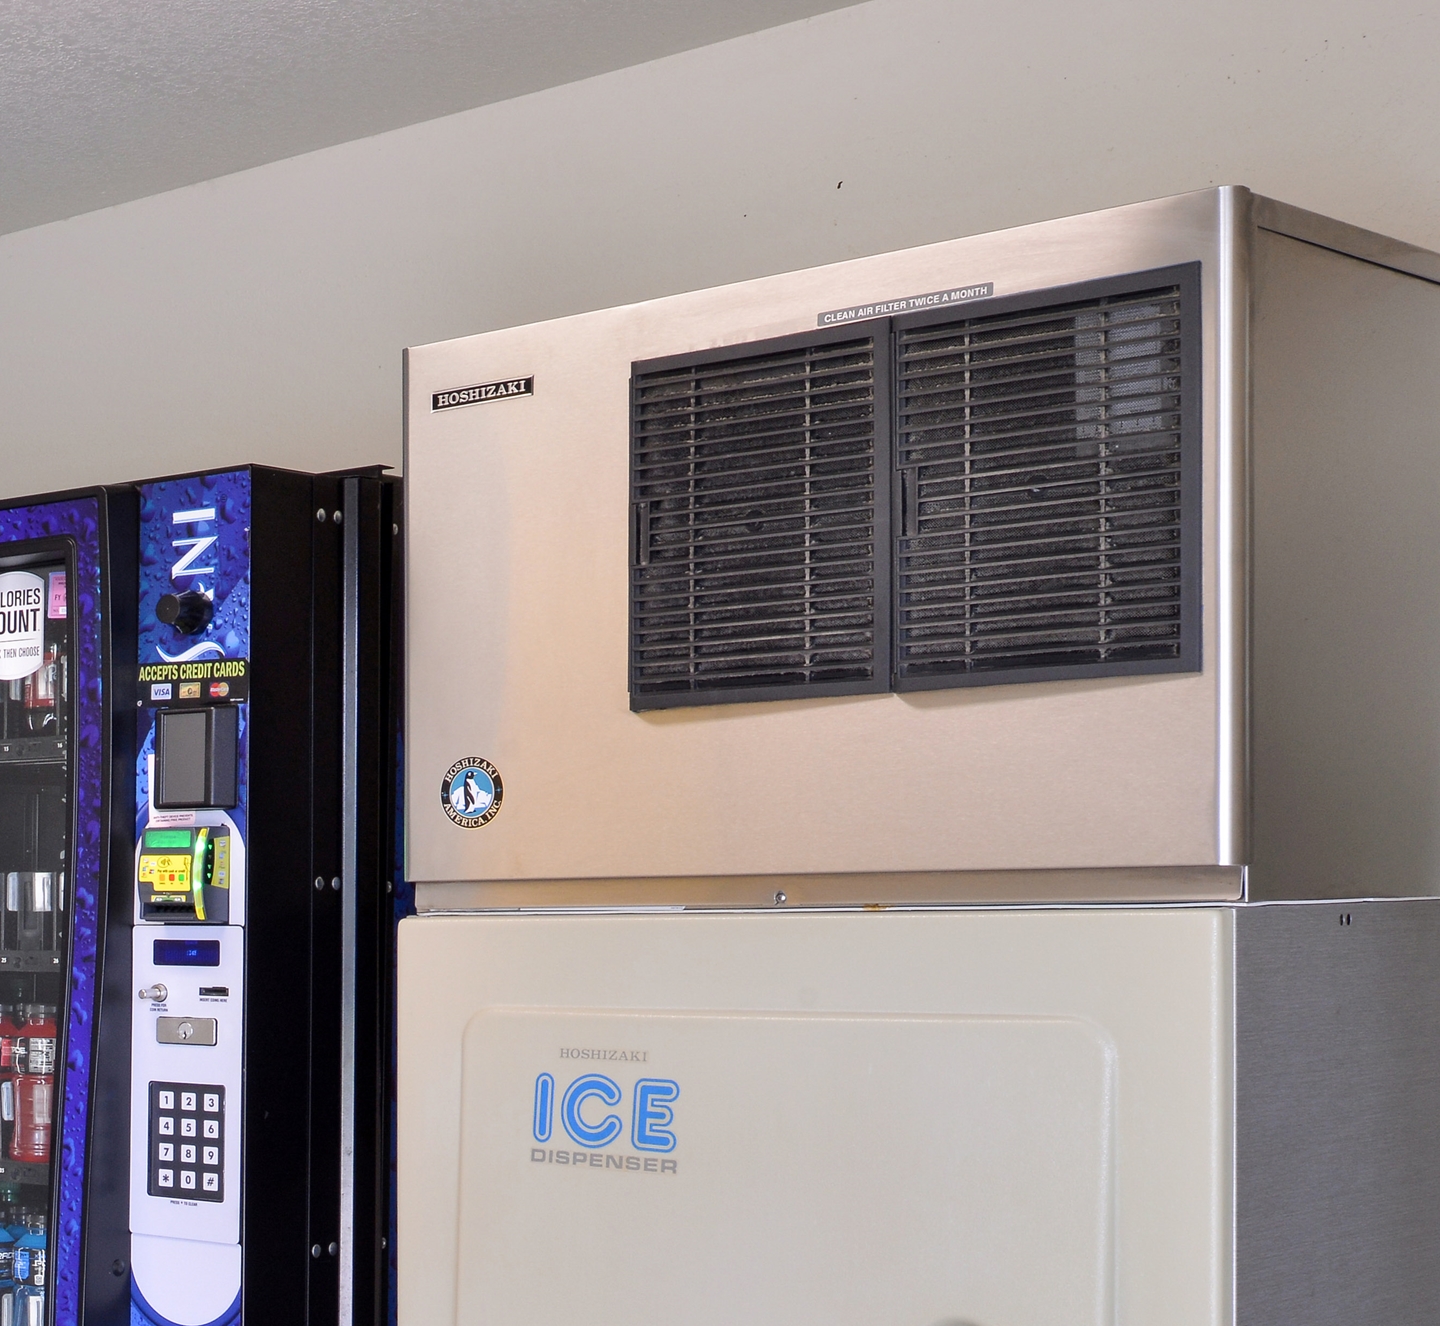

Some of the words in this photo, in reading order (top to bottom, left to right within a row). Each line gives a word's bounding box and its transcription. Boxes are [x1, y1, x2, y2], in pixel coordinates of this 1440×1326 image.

[824, 309, 855, 323] CLEAN
[857, 305, 873, 318] AIR
[875, 300, 907, 315] FILTER
[909, 294, 940, 308] TWICE
[941, 292, 949, 302] A
[951, 286, 988, 300] MONTH
[437, 380, 526, 407] HOSHIZAKI
[3, 648, 17, 659] THEN
[18, 646, 40, 657] CHOOSE
[138, 664, 178, 681] ACCEPTS
[180, 662, 213, 680] CREDIT
[213, 661, 245, 678] CARDS
[154, 688, 170, 696] VISA
[445, 758, 498, 783] HOSHIZAKI
[560, 1047, 648, 1062] HOSHIZAKI
[164, 1095, 169, 1104] 1
[186, 1096, 192, 1106] 2
[208, 1098, 214, 1108] 3
[533, 1072, 681, 1153] ICE
[163, 1121, 169, 1131] 4
[186, 1123, 192, 1132] 5
[208, 1125, 214, 1134] 6
[163, 1147, 169, 1157] 7
[185, 1149, 192, 1159] 8
[208, 1151, 214, 1160] 9
[530, 1148, 678, 1174] DISPENSER
[185, 1175, 192, 1185] 0
[207, 1177, 215, 1187] #
